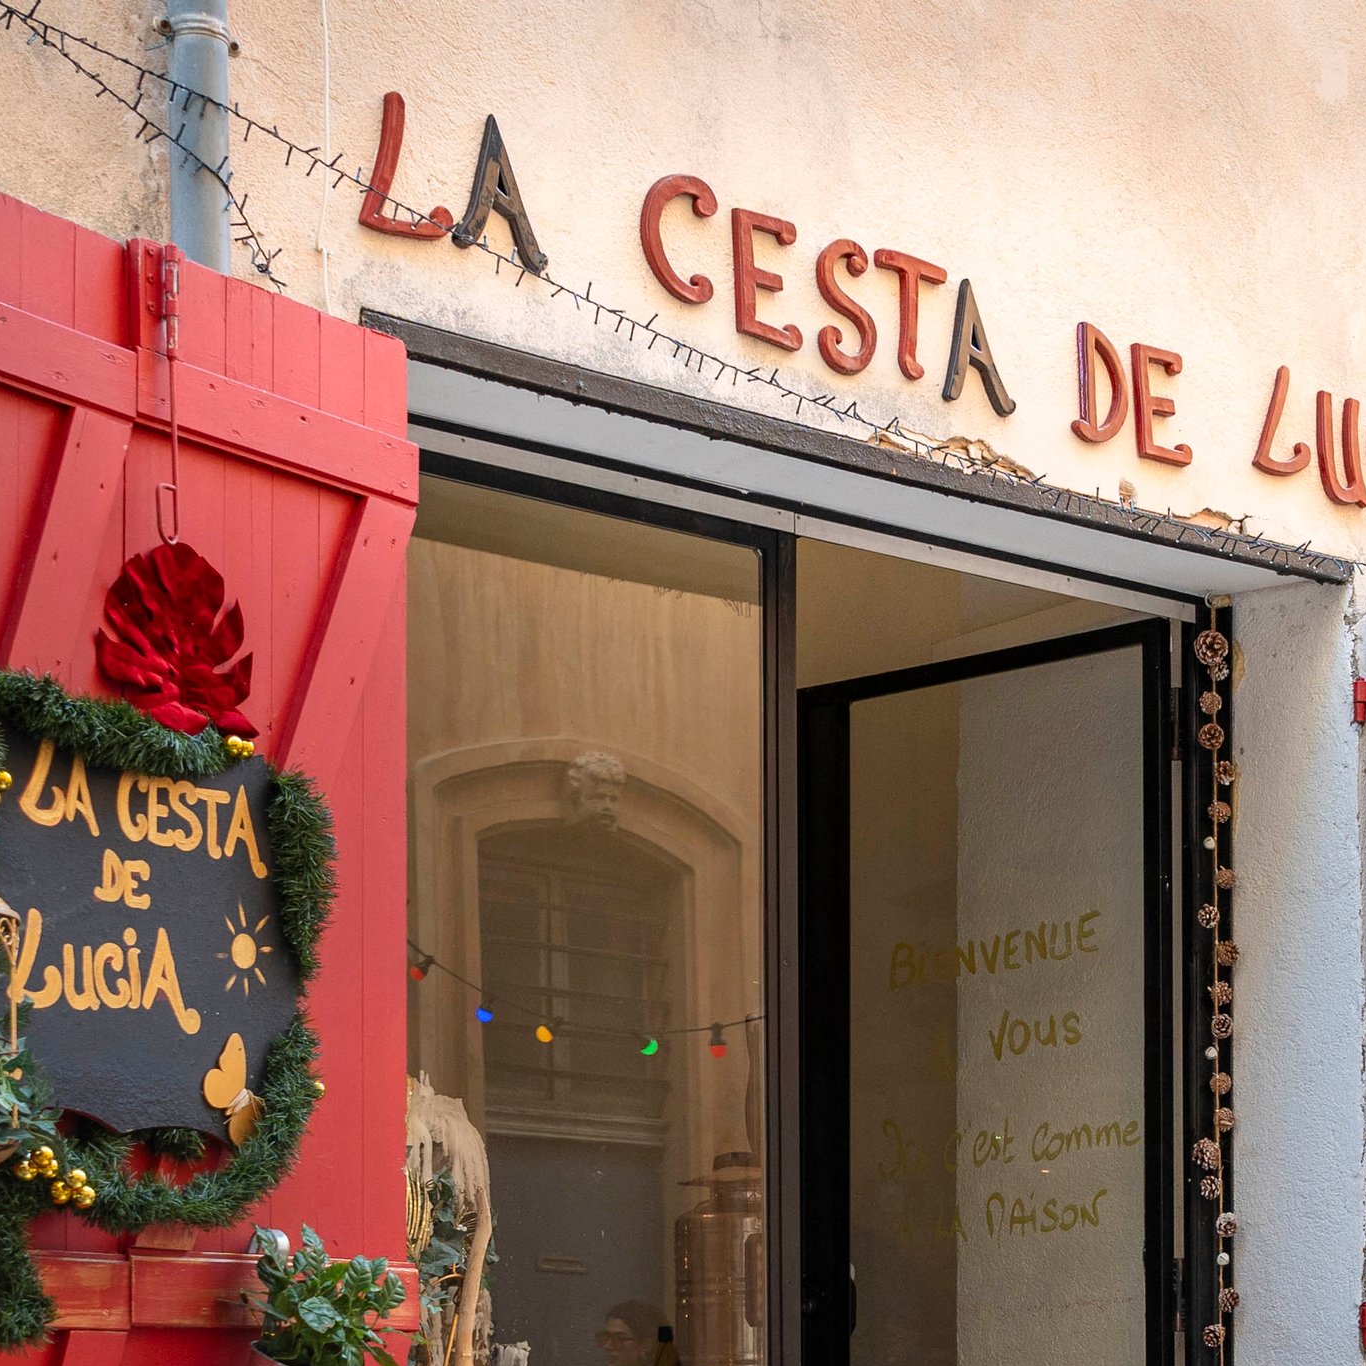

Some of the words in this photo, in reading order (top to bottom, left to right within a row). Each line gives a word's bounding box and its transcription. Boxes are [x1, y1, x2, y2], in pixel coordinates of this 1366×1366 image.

[359, 91, 548, 275] LA
[640, 173, 1017, 418] CESTA
[1071, 321, 1193, 467] DE
[20, 737, 100, 837] LA
[117, 771, 268, 878] CESTA
[93, 849, 151, 910] DE
[989, 1010, 1082, 1062] VOUS
